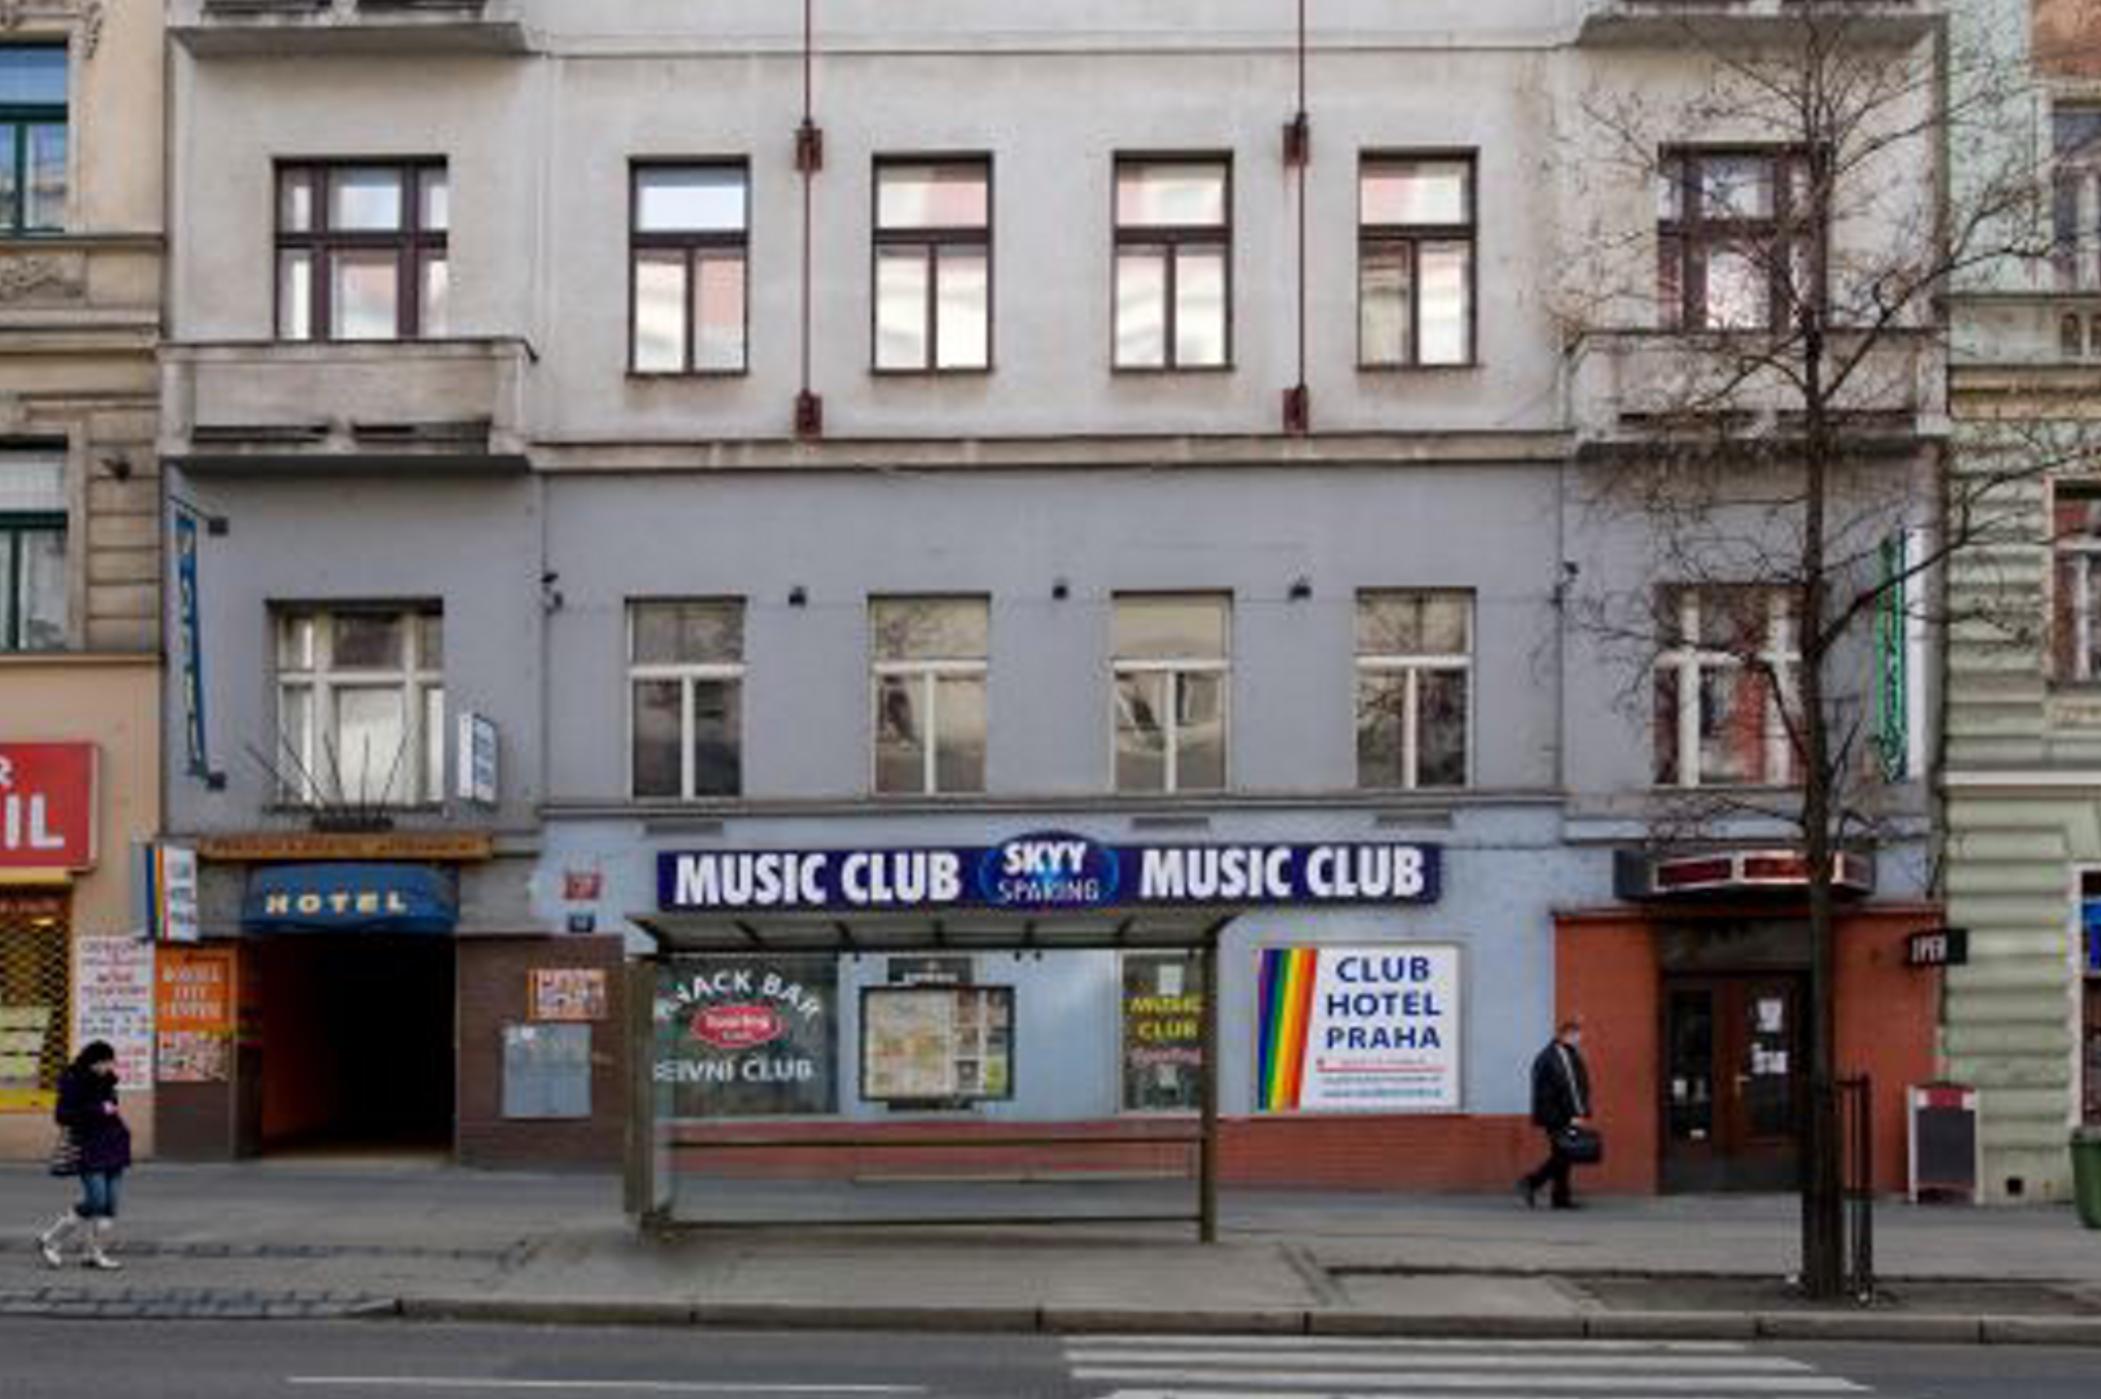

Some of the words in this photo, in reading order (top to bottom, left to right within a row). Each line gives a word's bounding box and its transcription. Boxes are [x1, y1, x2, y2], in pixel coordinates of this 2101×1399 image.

[1003, 842, 1087, 875] SKYY
[1141, 849, 1291, 898] MUSIC
[1306, 846, 1424, 897] CLUB
[674, 854, 827, 905] MUSIC
[841, 852, 961, 902] CLUB
[265, 888, 406, 915] HOTEL
[1336, 956, 1430, 983] CLUB
[1327, 990, 1442, 1017] HOTEL
[1327, 1026, 1441, 1049] PRAHA
[742, 1057, 814, 1082] CLUB
